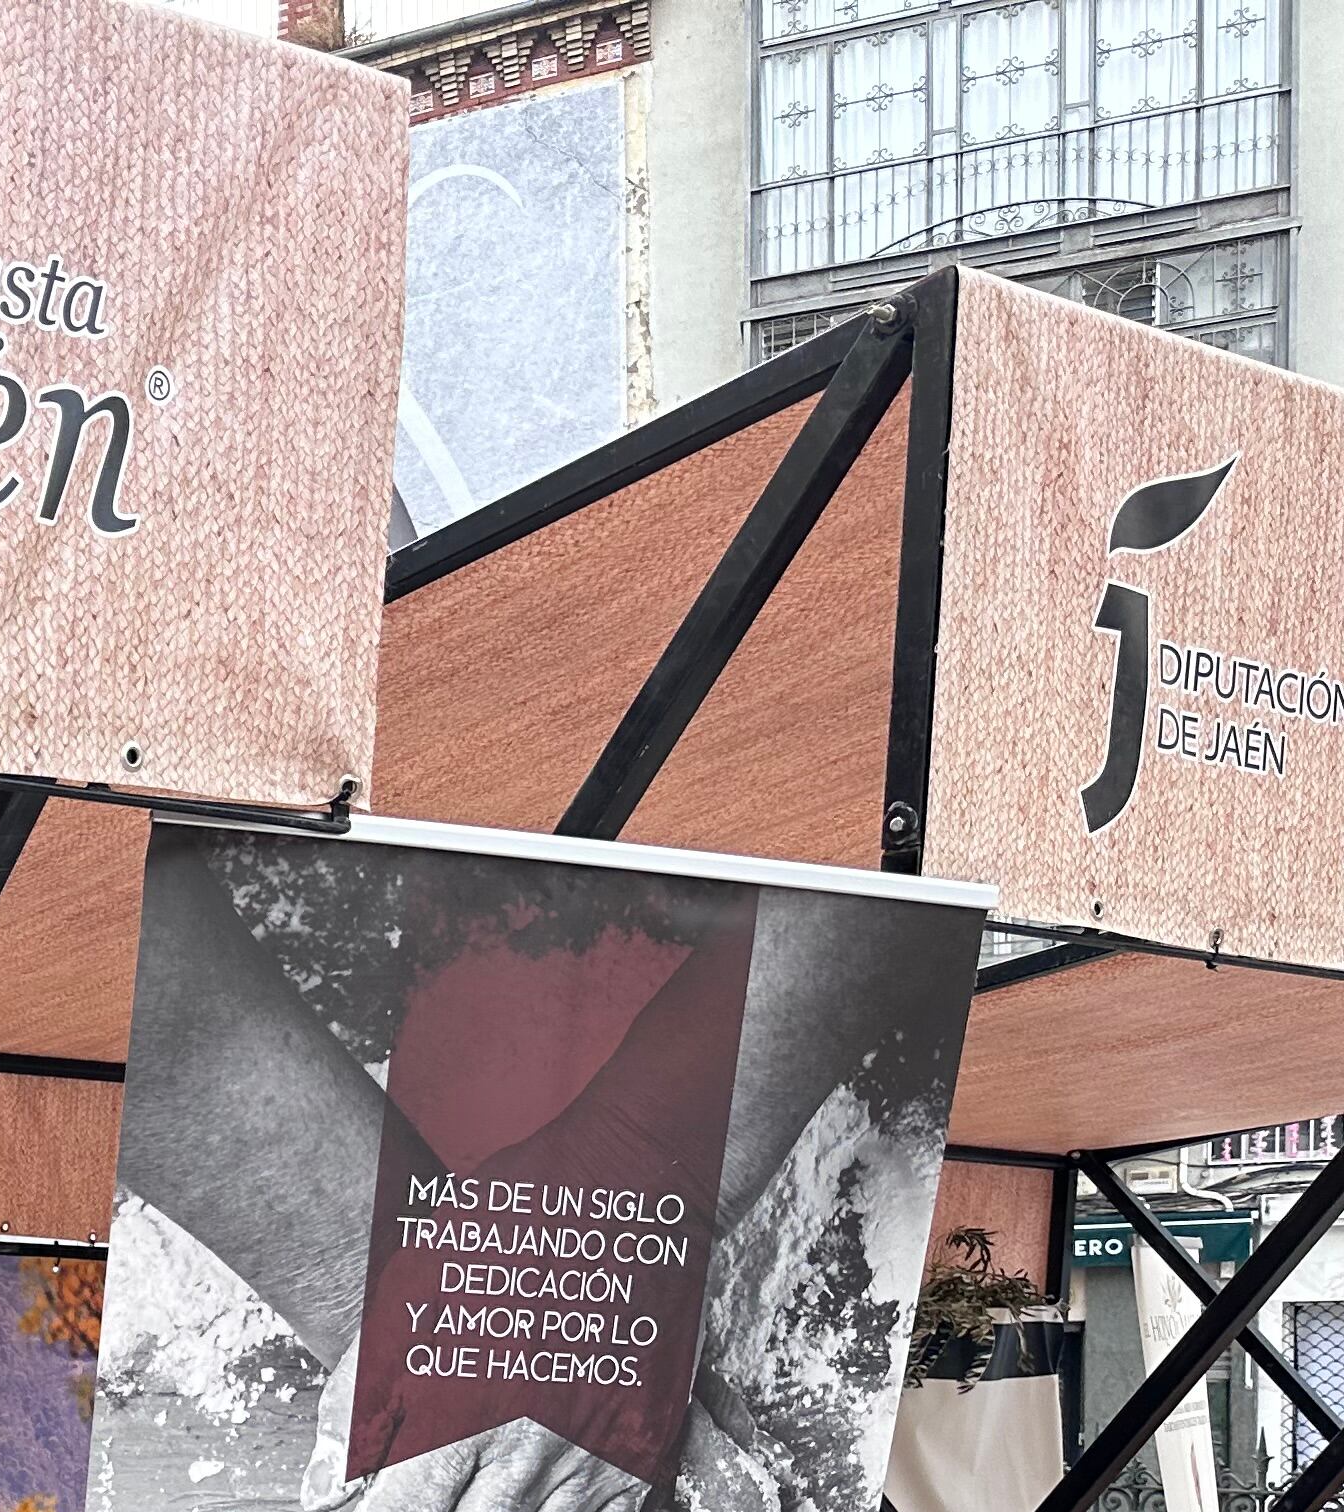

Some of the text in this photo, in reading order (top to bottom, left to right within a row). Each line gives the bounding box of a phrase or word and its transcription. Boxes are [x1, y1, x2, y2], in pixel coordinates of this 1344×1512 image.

[1158, 710, 1285, 774] DE JAÉN
[408, 1173, 685, 1225] MÁS DE UN SIGLO
[397, 1217, 688, 1267] TRABAJANDO CON
[1074, 1238, 1123, 1256] ERO
[440, 1262, 632, 1304] DEDICACIÓN
[406, 1302, 657, 1347] Y AMOR POR LO
[406, 1344, 642, 1387] QUE HACEMOS.
